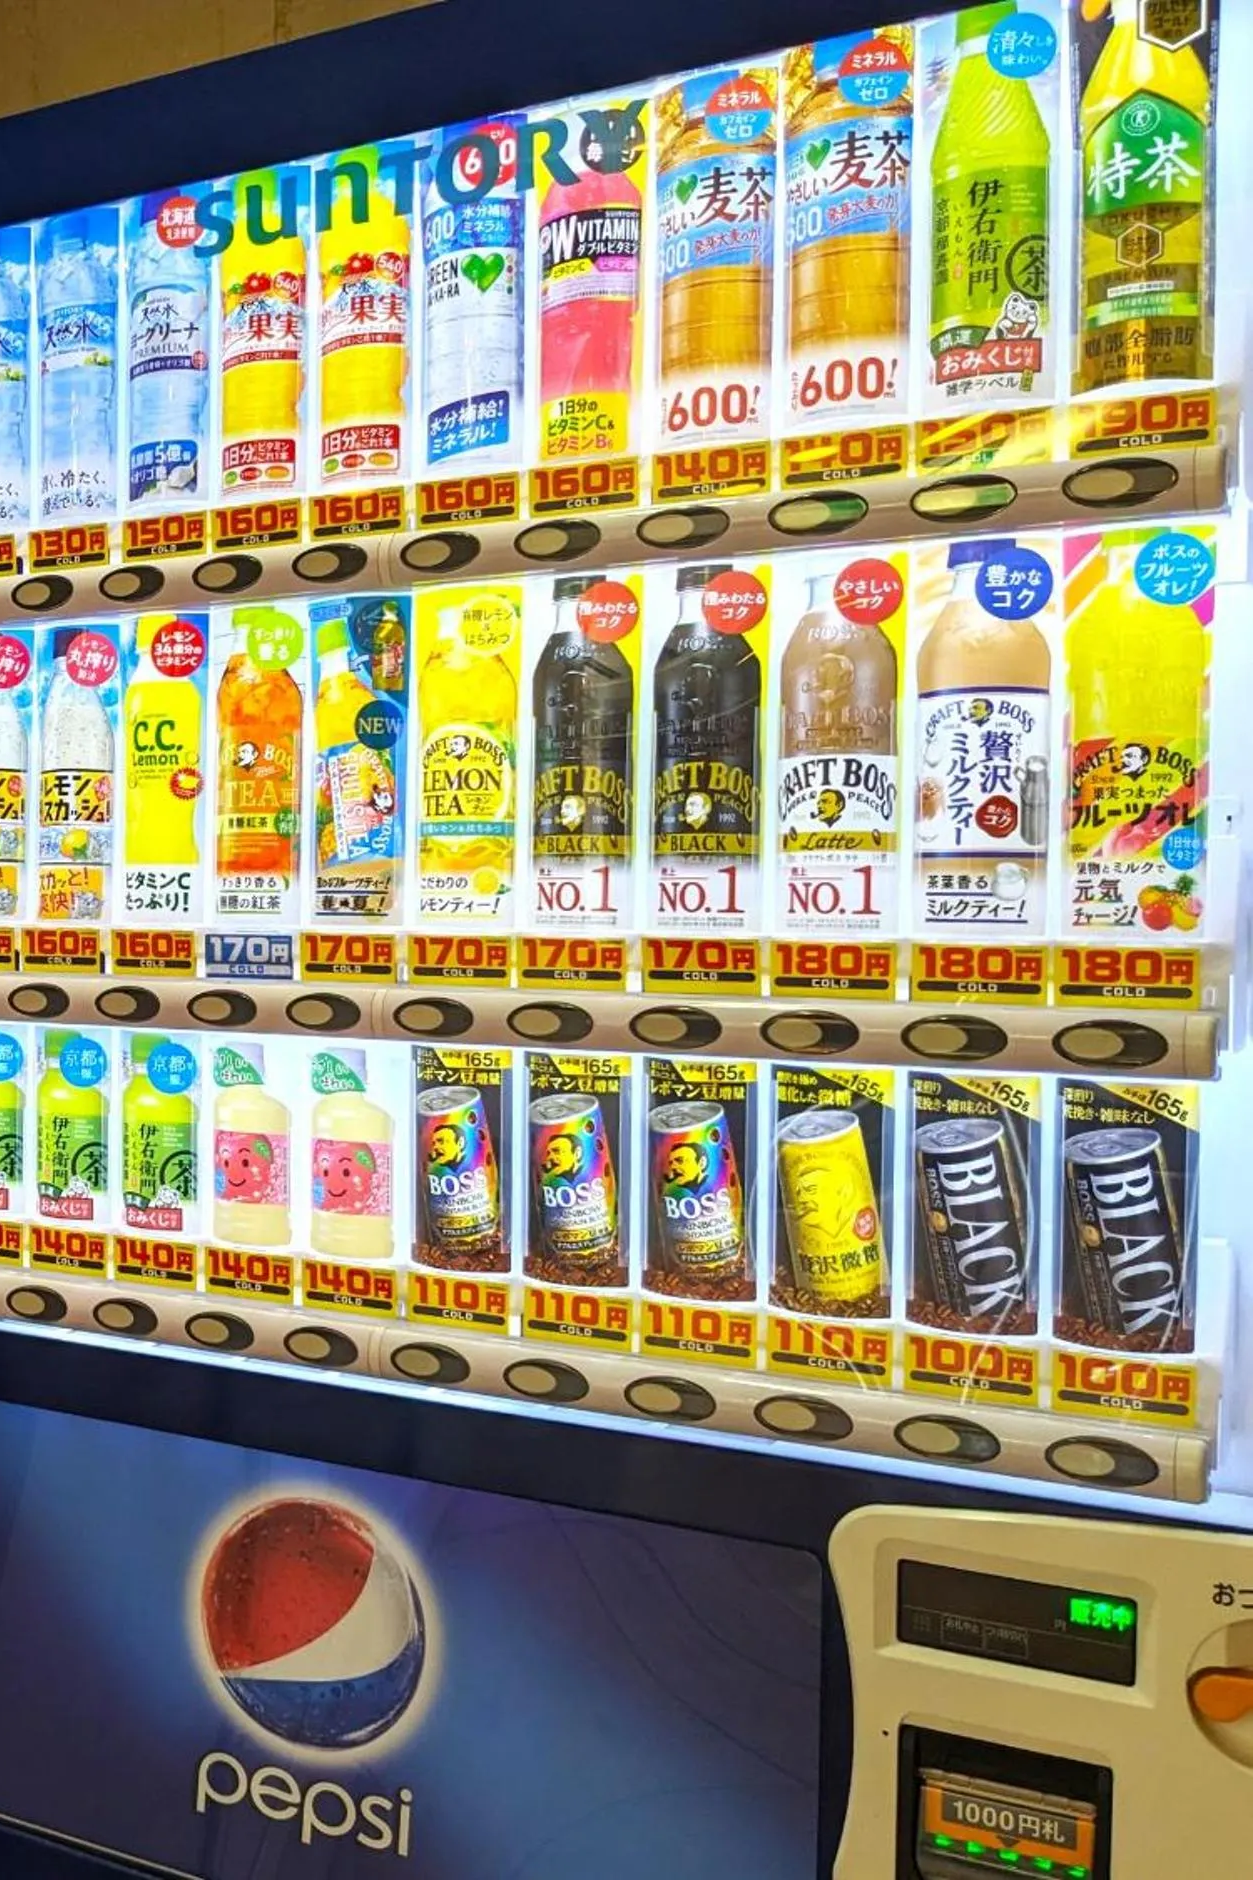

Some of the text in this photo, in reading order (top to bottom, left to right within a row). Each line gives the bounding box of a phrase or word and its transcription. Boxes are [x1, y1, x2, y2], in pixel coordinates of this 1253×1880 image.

[852, 53, 896, 69] ミネラル
[717, 90, 761, 108] ミネラル
[859, 87, 888, 101] ゼロ
[724, 124, 753, 139] ゼロ
[830, 131, 909, 194] 麦茶
[1087, 132, 1201, 203] 特茶
[697, 167, 774, 227] 麦茶
[577, 217, 639, 246] VITAMIN
[967, 178, 1005, 297] 伊右衛門
[350, 293, 405, 323] 果実
[44, 318, 99, 351] 天然水
[248, 310, 302, 341] 果実
[800, 357, 898, 407] 600!
[429, 398, 505, 436] 水分補給!
[558, 398, 598, 416] 1日分の
[668, 384, 761, 433] 600!
[1075, 396, 1210, 436] 190円
[430, 423, 497, 453] ミネラル!
[1119, 435, 1162, 447] COLD
[657, 449, 766, 485] 140円
[420, 477, 515, 513] 160円
[533, 464, 635, 502] 160円
[216, 505, 299, 537] 160円
[313, 492, 401, 528] 160円
[31, 526, 106, 559] 130円
[126, 516, 204, 549] 150円
[151, 545, 177, 555] COLD
[1153, 544, 1199, 560] ボスの
[985, 563, 1042, 587] 豊かな
[1141, 560, 1208, 580] フルーツ
[838, 580, 899, 595] やさしい
[993, 589, 1034, 611] コク
[1153, 578, 1197, 596] オレ!
[594, 615, 620, 629] コク
[720, 606, 746, 620] コク
[160, 631, 196, 643] レモン
[464, 632, 511, 646] はちみつ
[358, 715, 402, 736] NEW
[925, 700, 1036, 739] CRAFT BOSS
[133, 720, 183, 753] C.C.
[980, 730, 1013, 795] 贅沢
[1156, 749, 1198, 791] BOSS
[44, 775, 92, 797] レモン
[226, 780, 281, 809] TEA
[423, 769, 503, 792] LEMON
[842, 757, 897, 821] BOSS
[949, 733, 977, 846] ミルクティー
[1093, 786, 1169, 801] 果実つまった
[424, 793, 465, 817] TEA
[1071, 800, 1198, 830] フルーツオレ
[546, 835, 601, 852] BLACK
[671, 835, 726, 852] BLACK
[801, 833, 863, 852] Latte
[1077, 860, 1166, 876] 果物とミルクで
[1075, 878, 1123, 901] 元気
[927, 900, 1026, 919] ミルクティー!
[1073, 903, 1137, 925] チャージ!
[24, 930, 97, 955] 160円
[115, 931, 193, 958] 160円
[210, 936, 291, 963] 170円
[305, 936, 392, 965] 170円
[412, 937, 507, 968] 170円
[522, 941, 623, 970] 170円
[646, 940, 756, 972] 170円
[228, 965, 265, 974] COLD
[776, 944, 890, 977] 180円
[918, 947, 1043, 981] 180円
[1060, 949, 1194, 985] 180円
[811, 978, 849, 988] COLD
[53, 1115, 71, 1184] 伊右衛門
[140, 1123, 158, 1195] 伊右衛門
[429, 1167, 485, 1196] BOSS
[543, 1177, 606, 1208] BOSS
[665, 1187, 730, 1219] BOSS
[32, 1227, 108, 1261] 140円
[936, 1150, 1025, 1319] BLACK
[1089, 1163, 1182, 1336] BLACK
[116, 1235, 193, 1271] 140円
[209, 1249, 290, 1285] 140円
[234, 1280, 262, 1292] COLD
[306, 1261, 393, 1299] 140円
[414, 1275, 506, 1314] 110円
[530, 1289, 627, 1329] 110円
[648, 1304, 752, 1345] 110円
[679, 1341, 714, 1352] COLD
[774, 1320, 887, 1362] 110円
[910, 1336, 1033, 1382] 100円
[1059, 1355, 1190, 1401] 100円
[1100, 1396, 1142, 1410] COLD
[1068, 1597, 1135, 1632] 販売中
[196, 1750, 414, 1858] pepsi
[952, 1800, 1065, 1842] 1000円札
